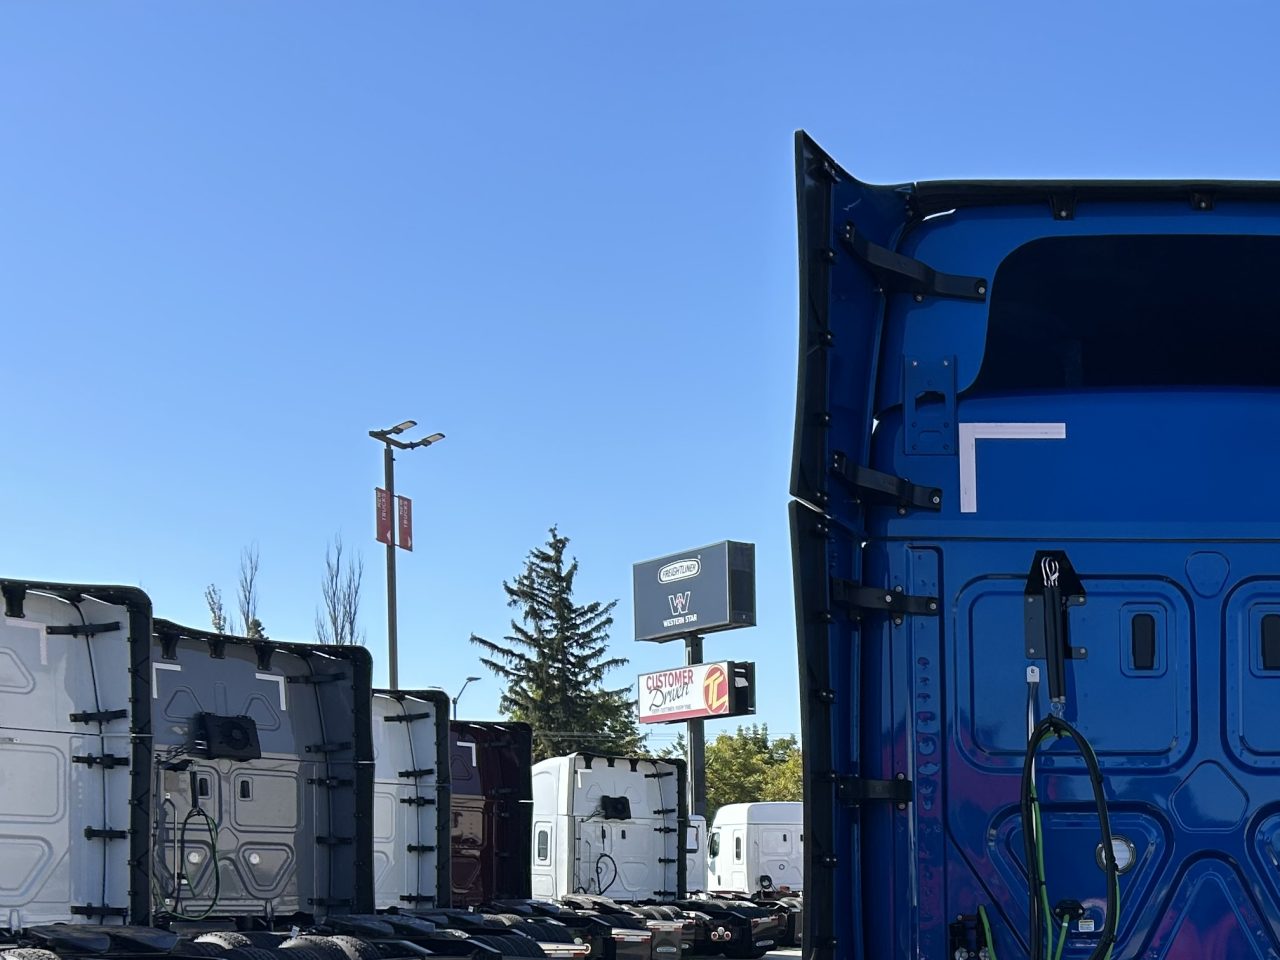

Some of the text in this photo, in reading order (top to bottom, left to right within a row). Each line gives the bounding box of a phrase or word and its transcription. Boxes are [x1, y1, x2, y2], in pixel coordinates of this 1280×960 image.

[661, 563, 697, 579] FREIGHTLINER
[663, 614, 697, 627] WESTERN STAR
[646, 669, 694, 690] CUSTOMER
[649, 682, 690, 711] Driven
